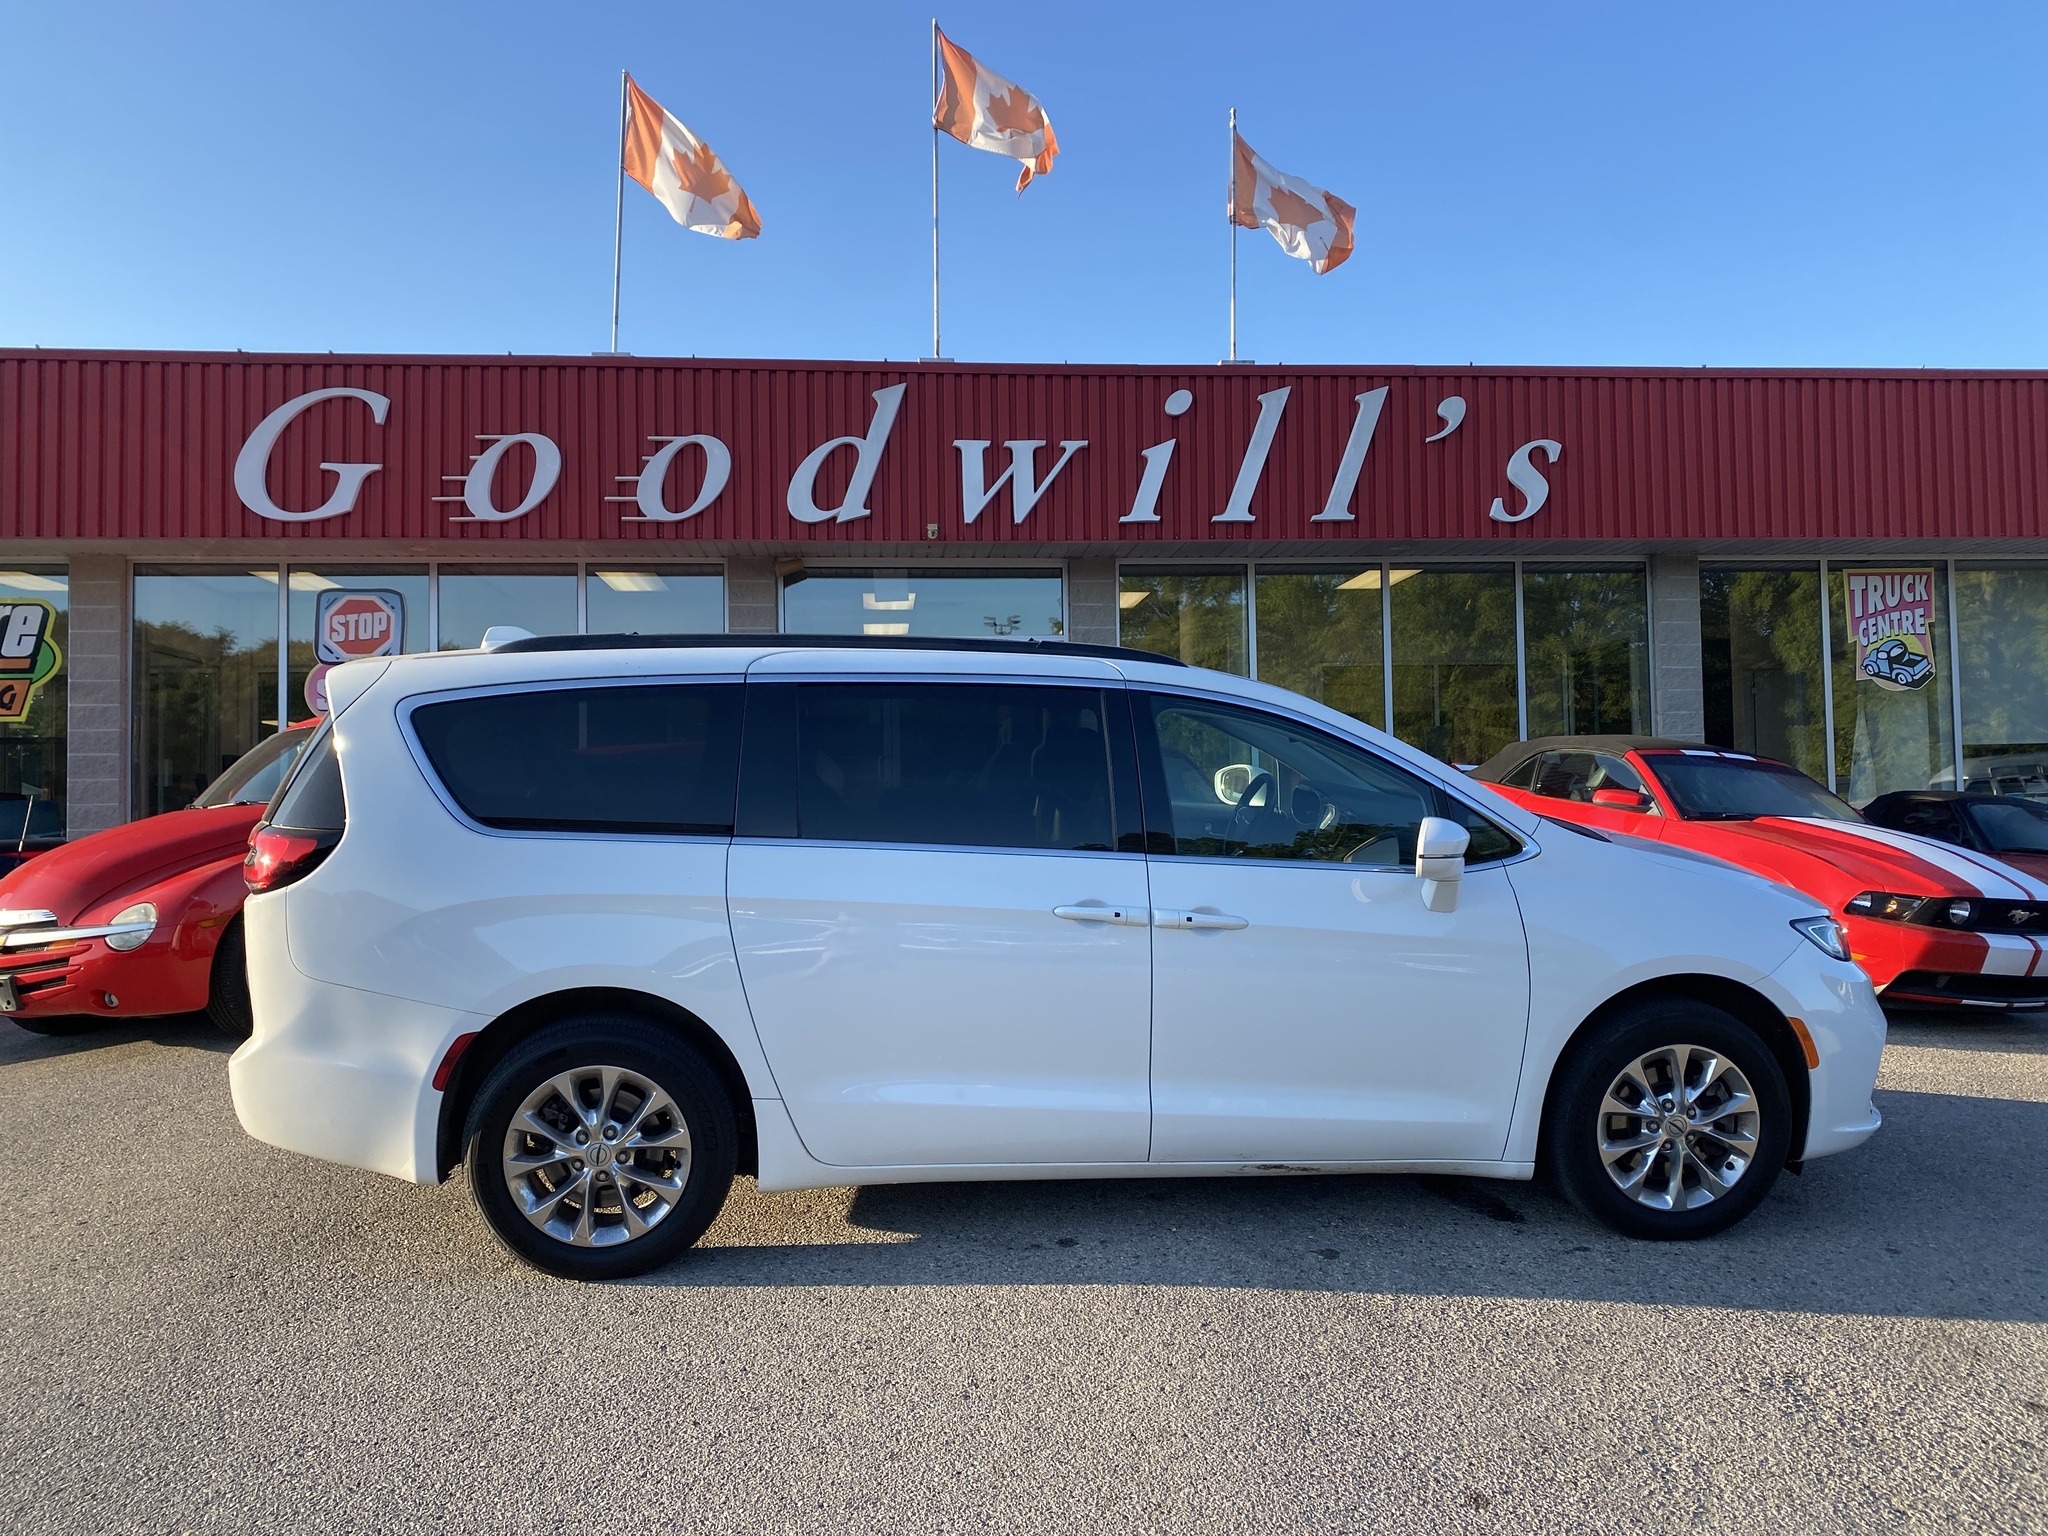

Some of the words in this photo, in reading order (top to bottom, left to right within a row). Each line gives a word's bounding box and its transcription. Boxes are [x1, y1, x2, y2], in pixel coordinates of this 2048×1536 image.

[233, 382, 1562, 524] Goodwill's
[1849, 574, 1929, 617] TRUCK
[331, 611, 388, 641] STOP
[1859, 608, 1926, 647] CENTRE
